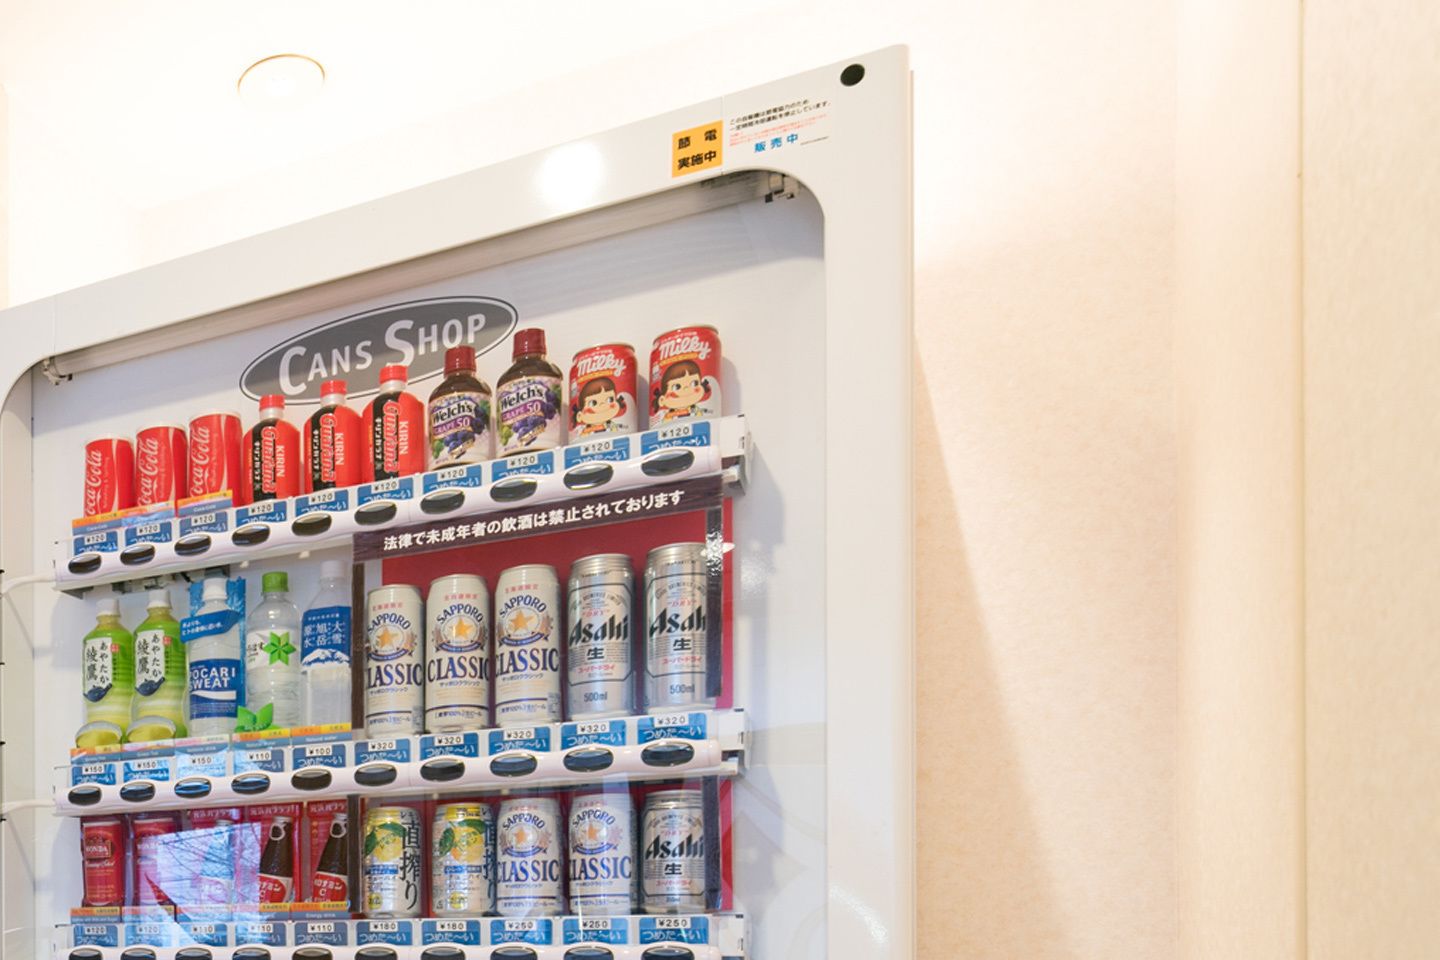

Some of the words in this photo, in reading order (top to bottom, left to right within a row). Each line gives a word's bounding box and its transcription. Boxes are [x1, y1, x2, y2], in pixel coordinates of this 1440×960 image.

[677, 129, 717, 150] 節電
[754, 133, 799, 153] 販売中
[677, 150, 717, 171] 実施中
[278, 340, 373, 396] CANS
[384, 313, 486, 368] SHOP
[659, 336, 711, 360] Milky
[576, 354, 627, 377] Milky
[501, 386, 545, 408] Welch's
[433, 402, 474, 424] Welch's
[526, 402, 541, 413] 50
[456, 418, 471, 428] 50
[661, 427, 690, 438] ¥120
[399, 421, 409, 455] KIRIN
[584, 442, 610, 452] ¥120
[335, 432, 345, 466] KIRIN
[275, 445, 285, 478] KIRIN
[510, 456, 535, 467] ¥120
[85, 449, 102, 516] oca-Cola
[440, 470, 464, 480] ¥120
[374, 481, 397, 491] ¥120
[311, 493, 333, 503] ¥120
[250, 504, 272, 514] ¥120
[138, 525, 159, 535] ¥120
[193, 515, 214, 525] ¥120
[383, 489, 685, 551] 法律で未成年者の飲酒は禁止されております
[86, 533, 106, 544] ¥120
[437, 602, 484, 624] SAPPORO
[499, 594, 547, 616] SAPPORO
[569, 613, 628, 647] Asahi
[649, 605, 707, 639] Asah
[586, 647, 605, 661] 生
[673, 637, 692, 652] 生
[99, 641, 110, 684] あやたか
[151, 633, 162, 678] あやたか
[496, 647, 559, 678] CLASSIC
[427, 655, 489, 682] CLASSIC
[584, 692, 608, 702] 500ml
[670, 684, 696, 694] 500ml
[580, 724, 607, 733] ¥320
[658, 716, 687, 726] ¥320
[437, 736, 461, 745] ¥320
[507, 730, 532, 739] ¥320
[371, 742, 393, 750] ¥320
[502, 812, 546, 831] SAPPORO
[572, 808, 616, 828] SAPPORO
[400, 820, 421, 911] 直搾り
[569, 856, 632, 882] LASSIC
[664, 862, 682, 876] 生
